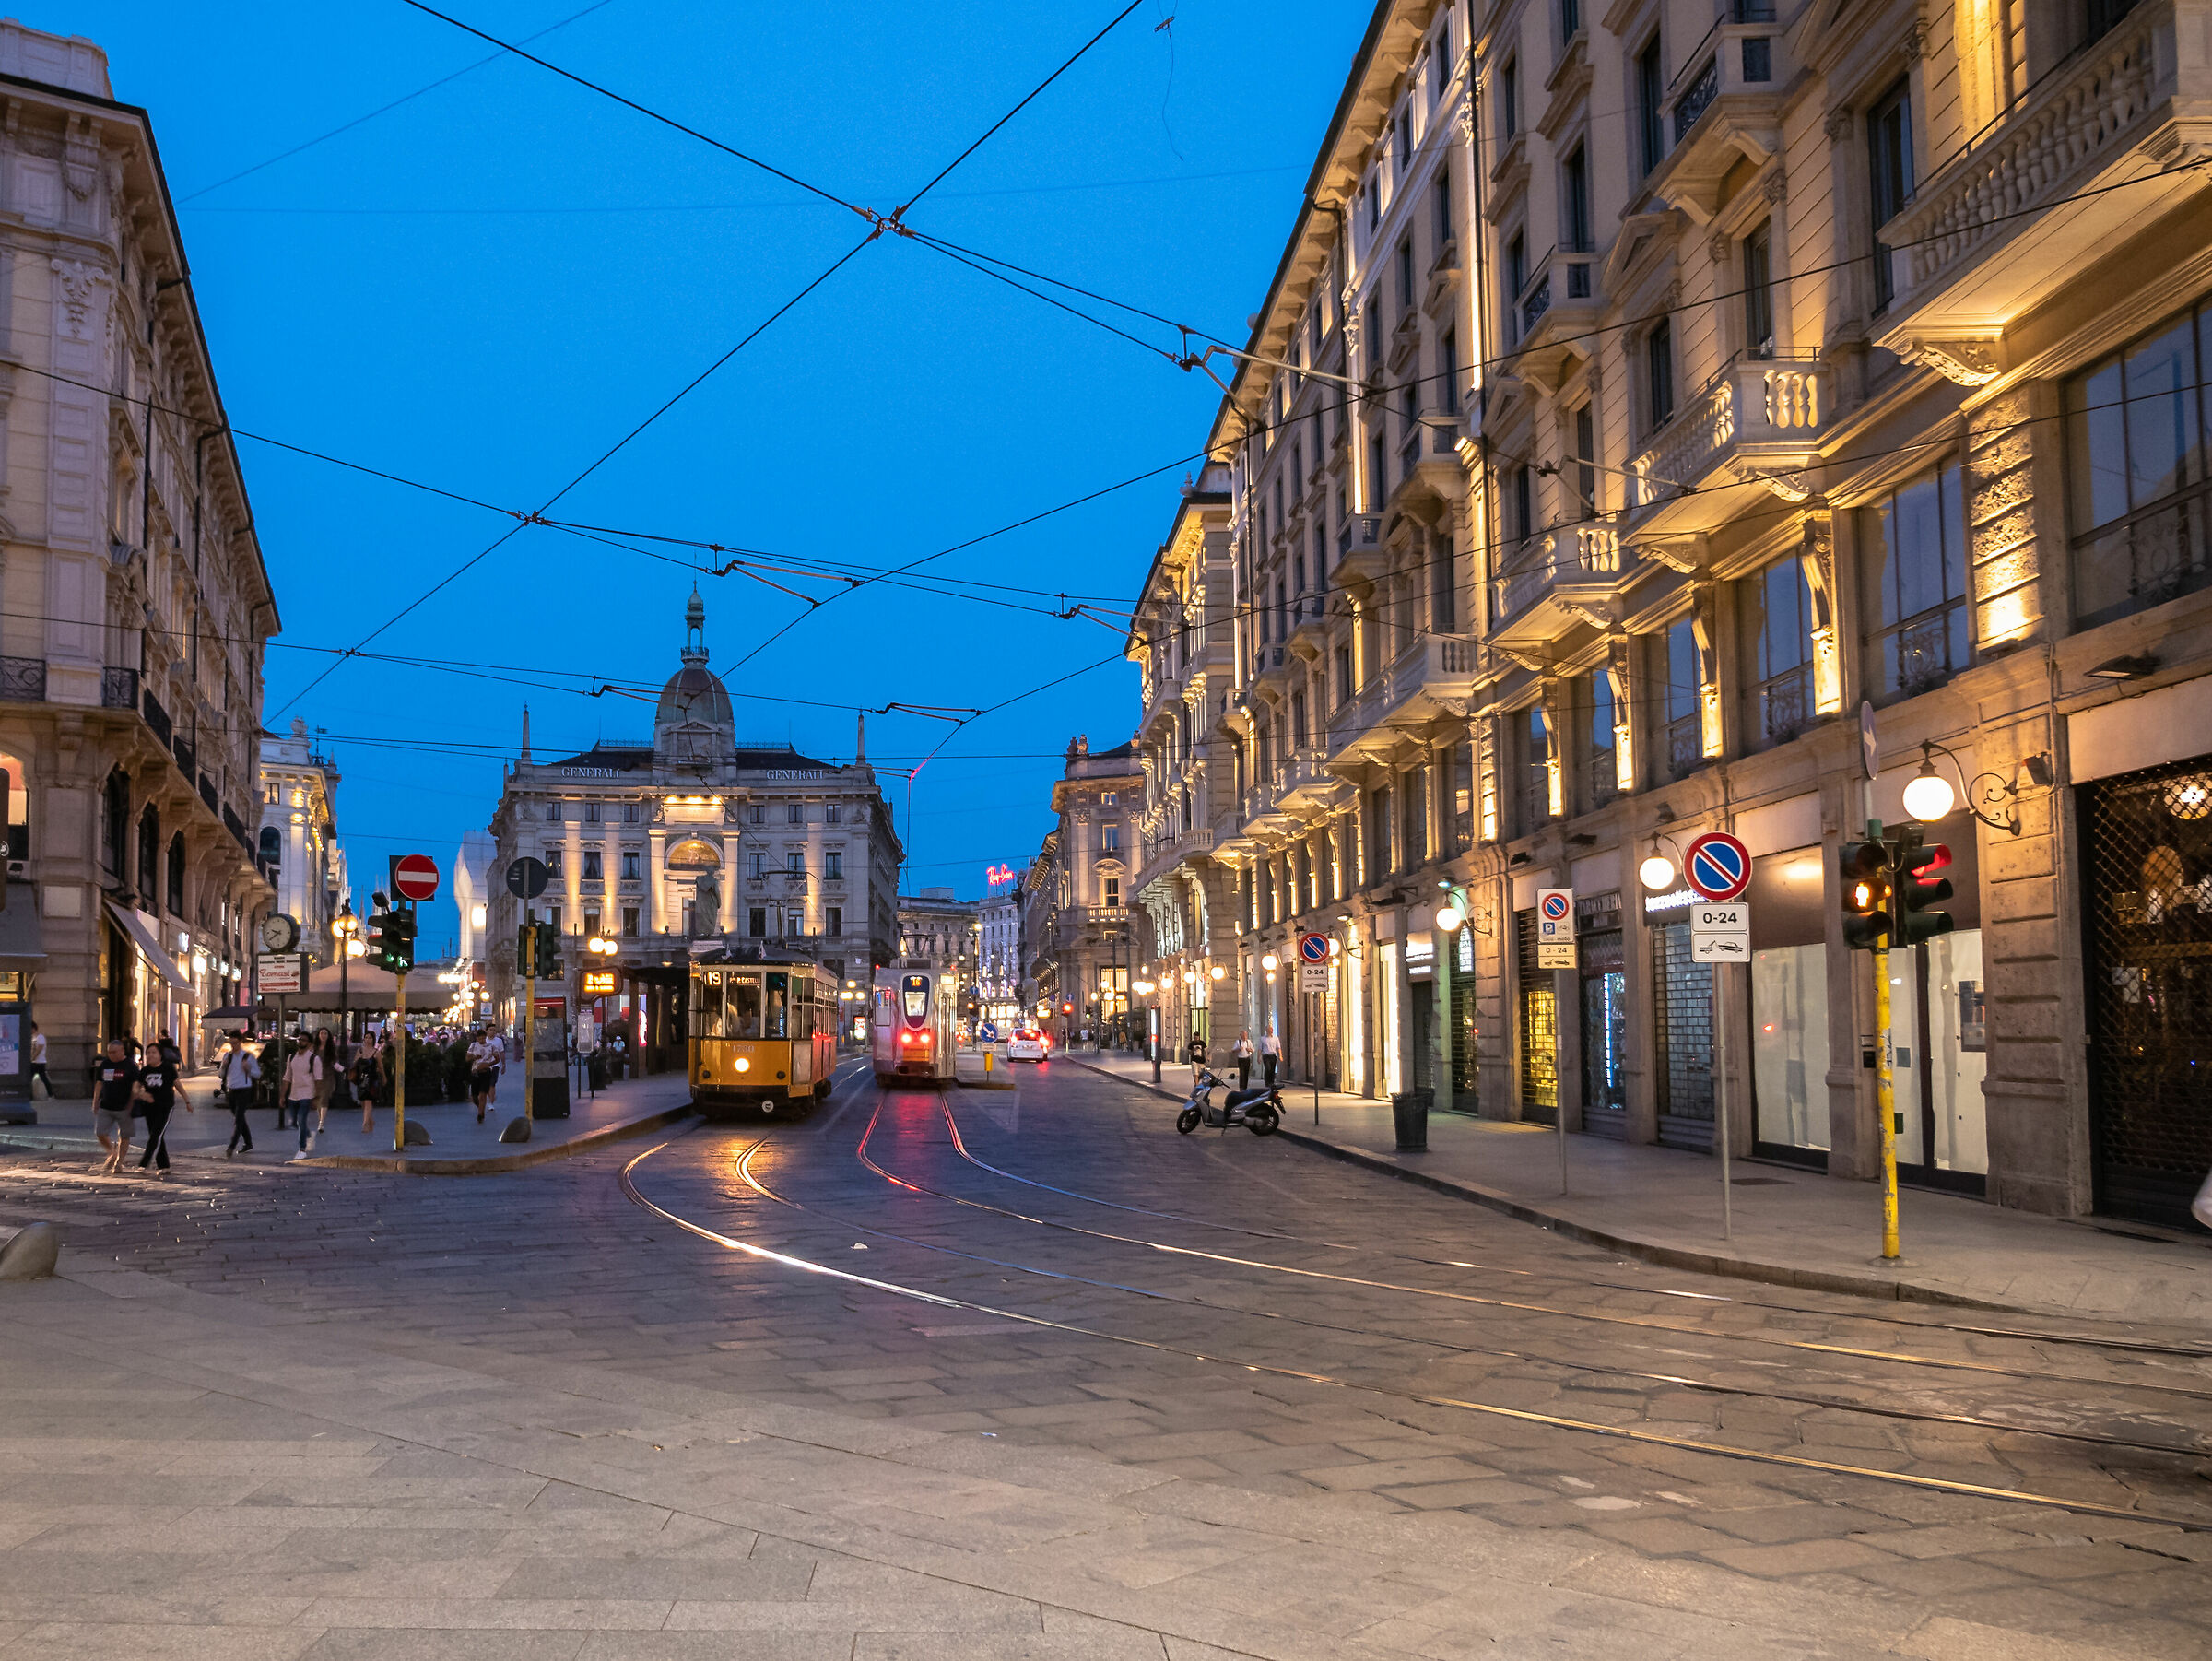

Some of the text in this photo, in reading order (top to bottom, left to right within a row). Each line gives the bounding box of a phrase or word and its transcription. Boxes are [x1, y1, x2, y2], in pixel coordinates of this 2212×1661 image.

[561, 767, 620, 779] GENERALI
[767, 769, 824, 780] GENERALI
[1702, 912, 1737, 924] 0-24
[707, 971, 722, 985] 19
